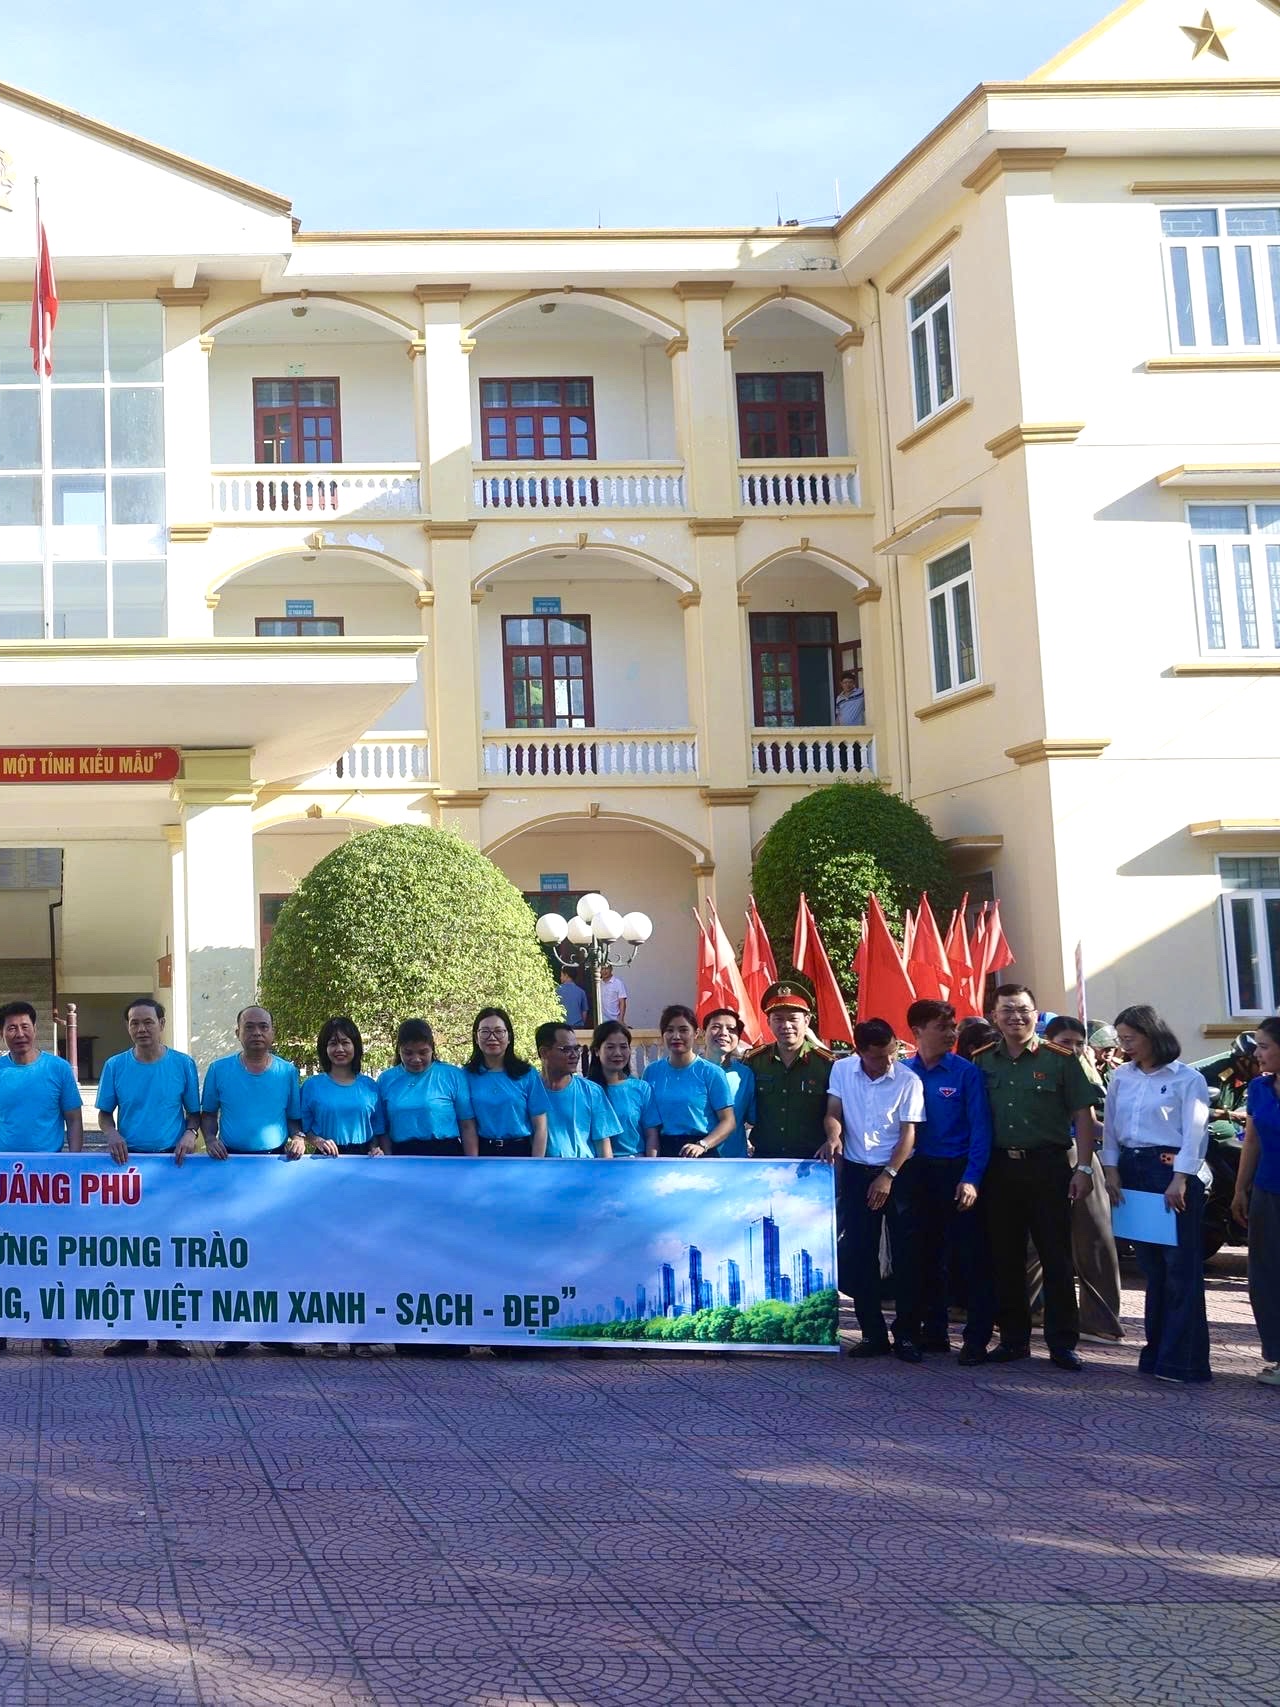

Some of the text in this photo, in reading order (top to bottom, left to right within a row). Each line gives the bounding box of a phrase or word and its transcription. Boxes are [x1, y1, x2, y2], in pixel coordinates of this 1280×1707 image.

[3, 753, 36, 778] MỘT
[40, 751, 75, 775] TỈNH
[79, 745, 114, 774] KIỂU
[81, 1168, 141, 1205] PHÚ
[58, 1235, 161, 1268] PHONG
[170, 1230, 249, 1269] TRÀO
[39, 1281, 65, 1320] VÌ
[75, 1281, 135, 1328] MỘT
[143, 1282, 203, 1329] VIỆT
[212, 1290, 278, 1323] NAM
[288, 1291, 366, 1324] XANH
[395, 1292, 473, 1333] SẠCH
